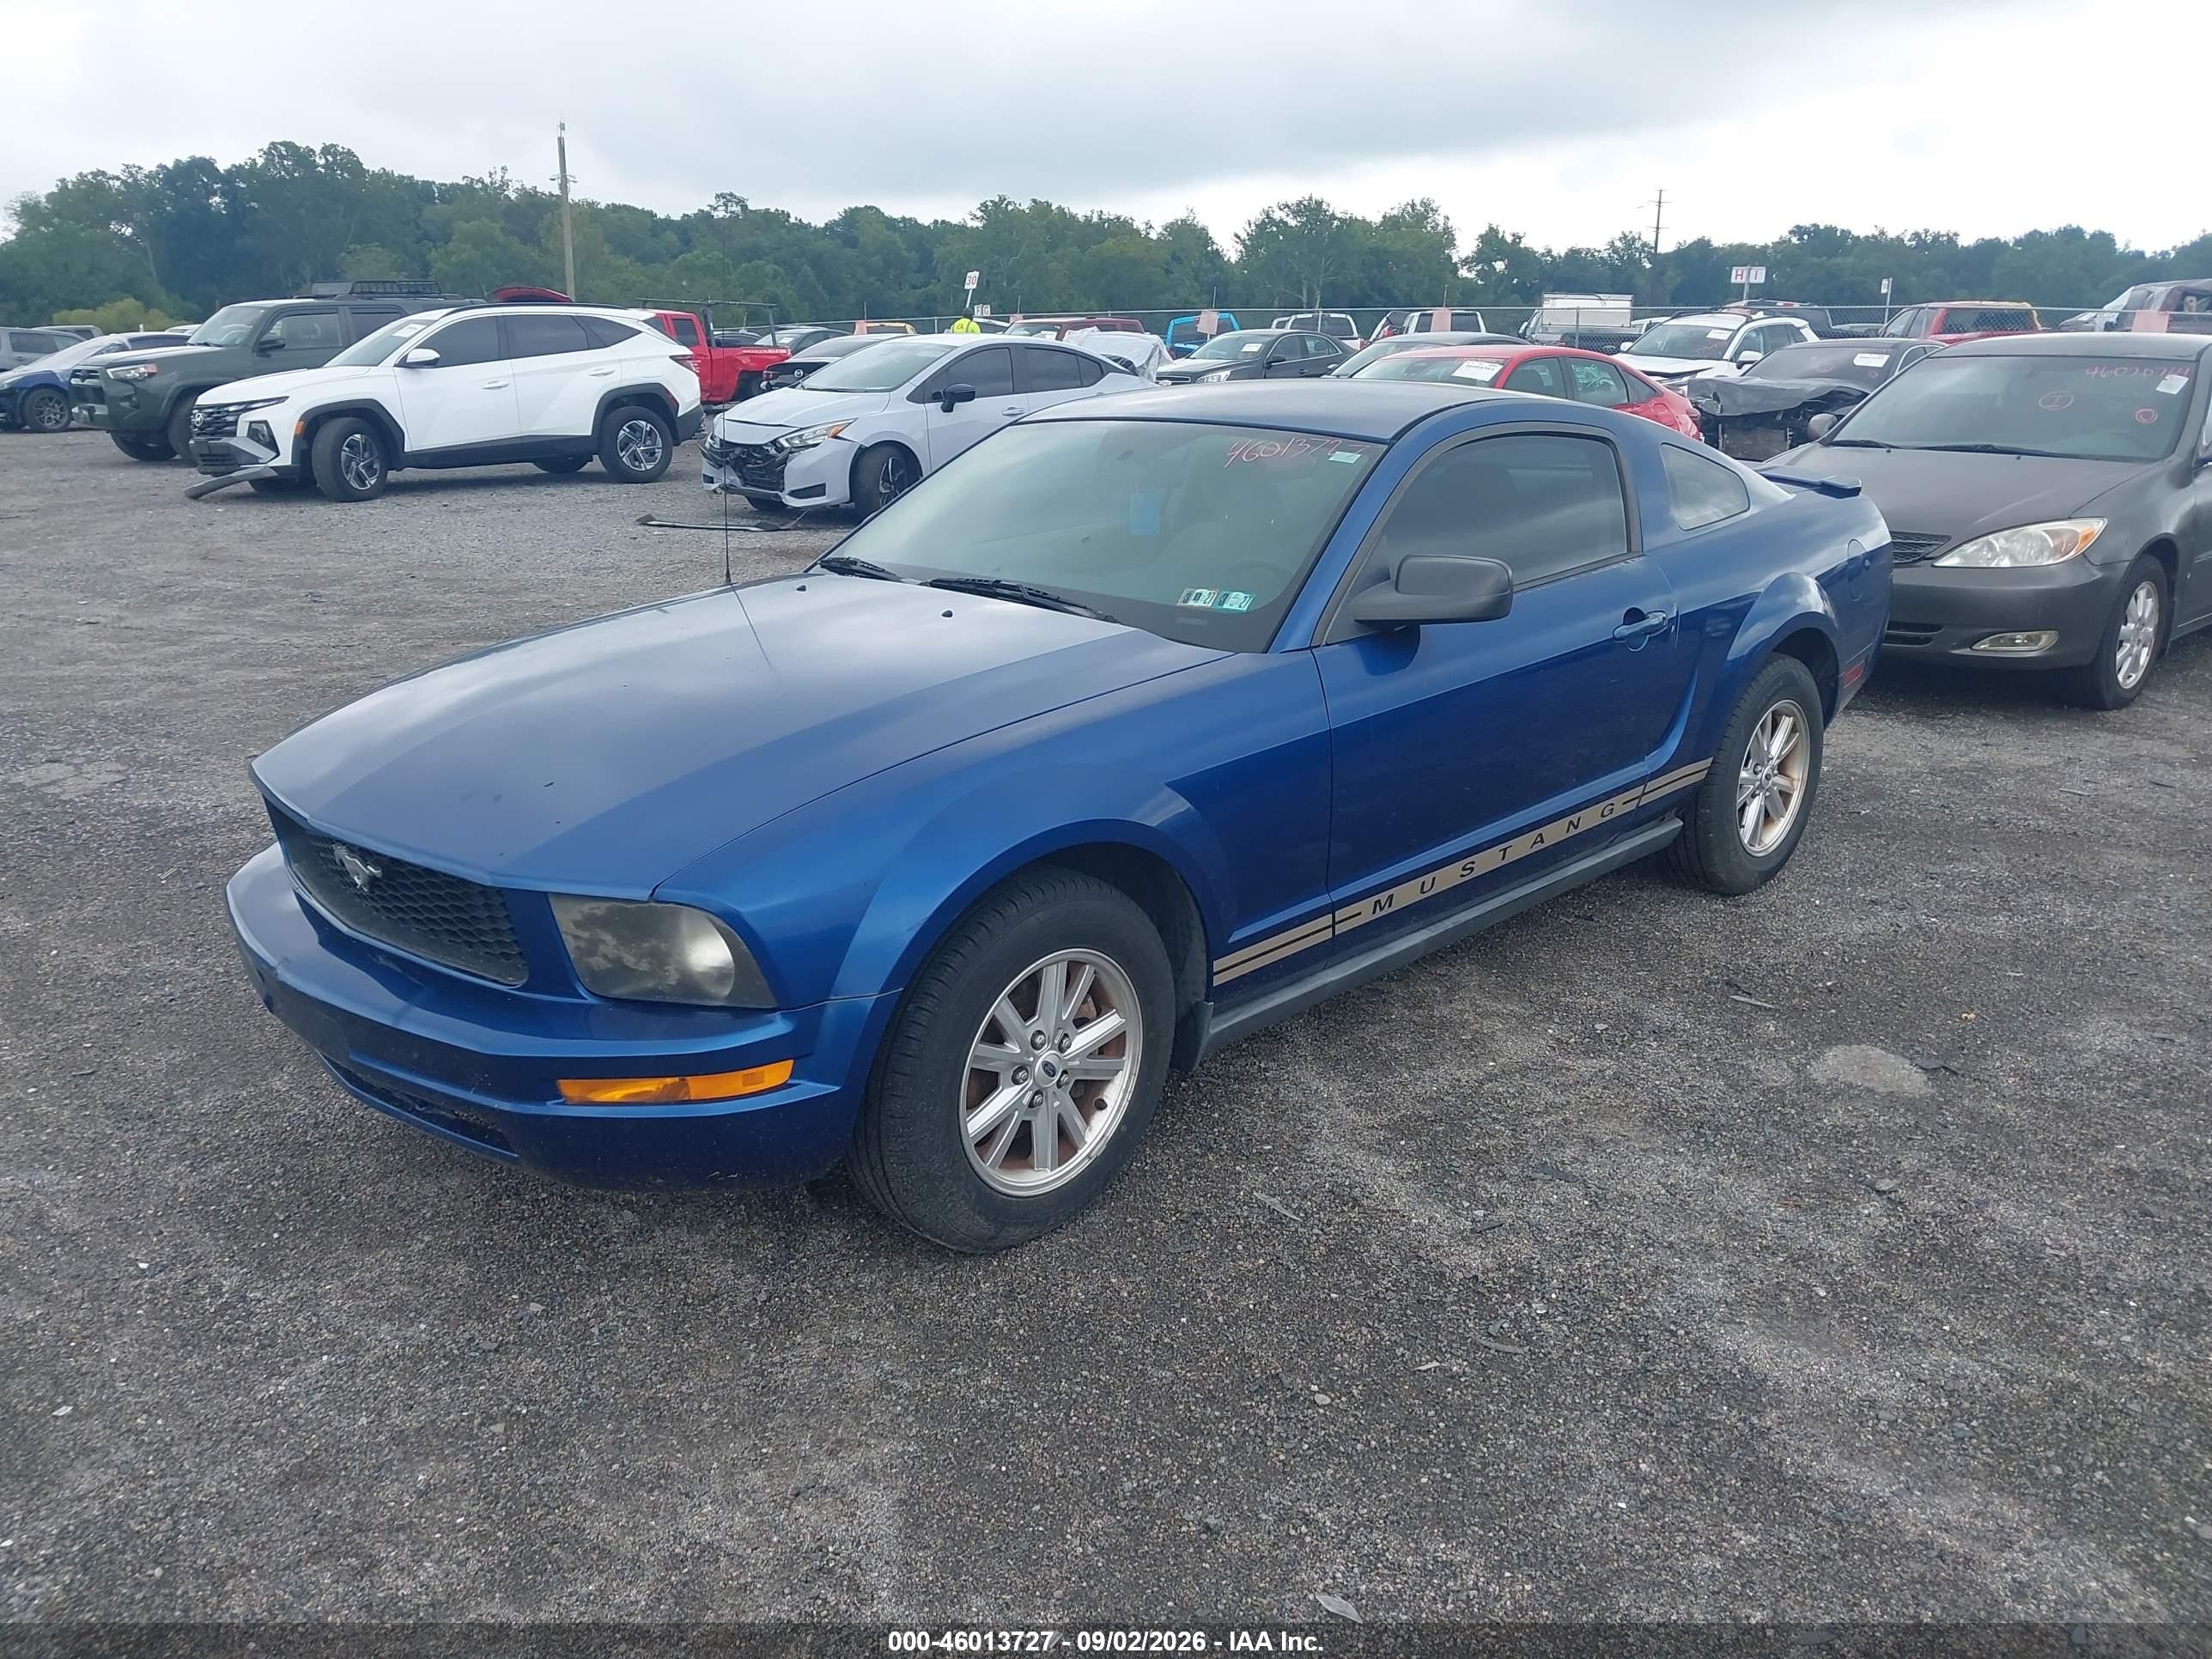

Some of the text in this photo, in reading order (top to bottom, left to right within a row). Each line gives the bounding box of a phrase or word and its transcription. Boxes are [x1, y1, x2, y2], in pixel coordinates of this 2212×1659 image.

[966, 275, 977, 285] 30
[1735, 269, 1744, 281] H
[975, 306, 989, 315] F G
[1203, 592, 1216, 605] 27
[1238, 596, 1252, 609] 27
[1371, 803, 1615, 915] MUSTANG
